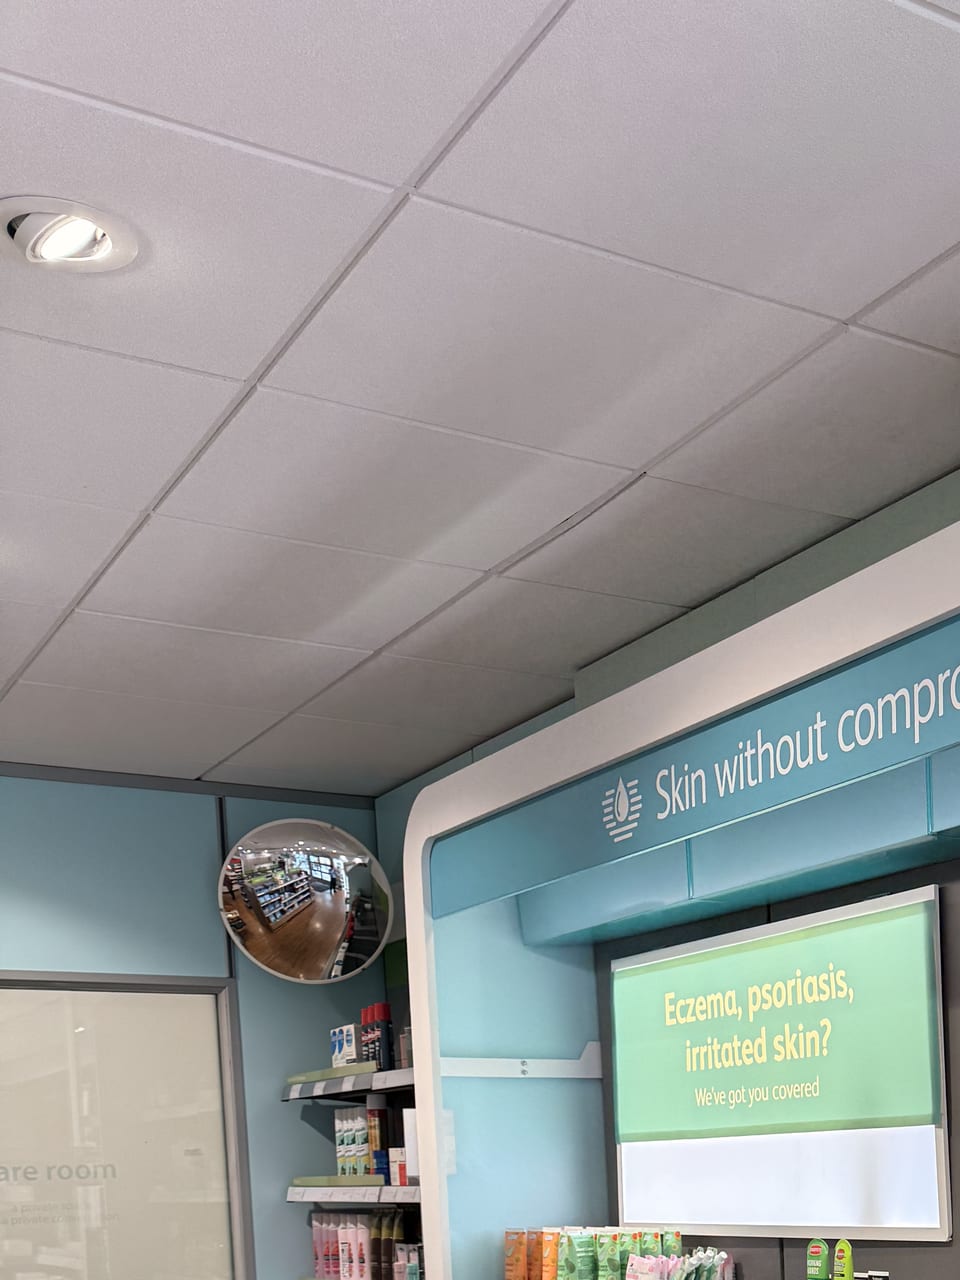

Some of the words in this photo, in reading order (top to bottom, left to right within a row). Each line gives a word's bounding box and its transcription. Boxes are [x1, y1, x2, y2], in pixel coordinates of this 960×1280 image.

[655, 764, 707, 821] Skin
[714, 710, 828, 799] without
[664, 987, 743, 1027] Eczema,
[747, 961, 855, 1023] psoriasis,
[685, 1026, 767, 1073] irritated
[773, 1017, 833, 1063] skin?
[695, 1086, 726, 1108] We've
[728, 1084, 746, 1110] got
[748, 1082, 770, 1108] you
[772, 1075, 820, 1101] covered
[47, 1163, 117, 1180] room
